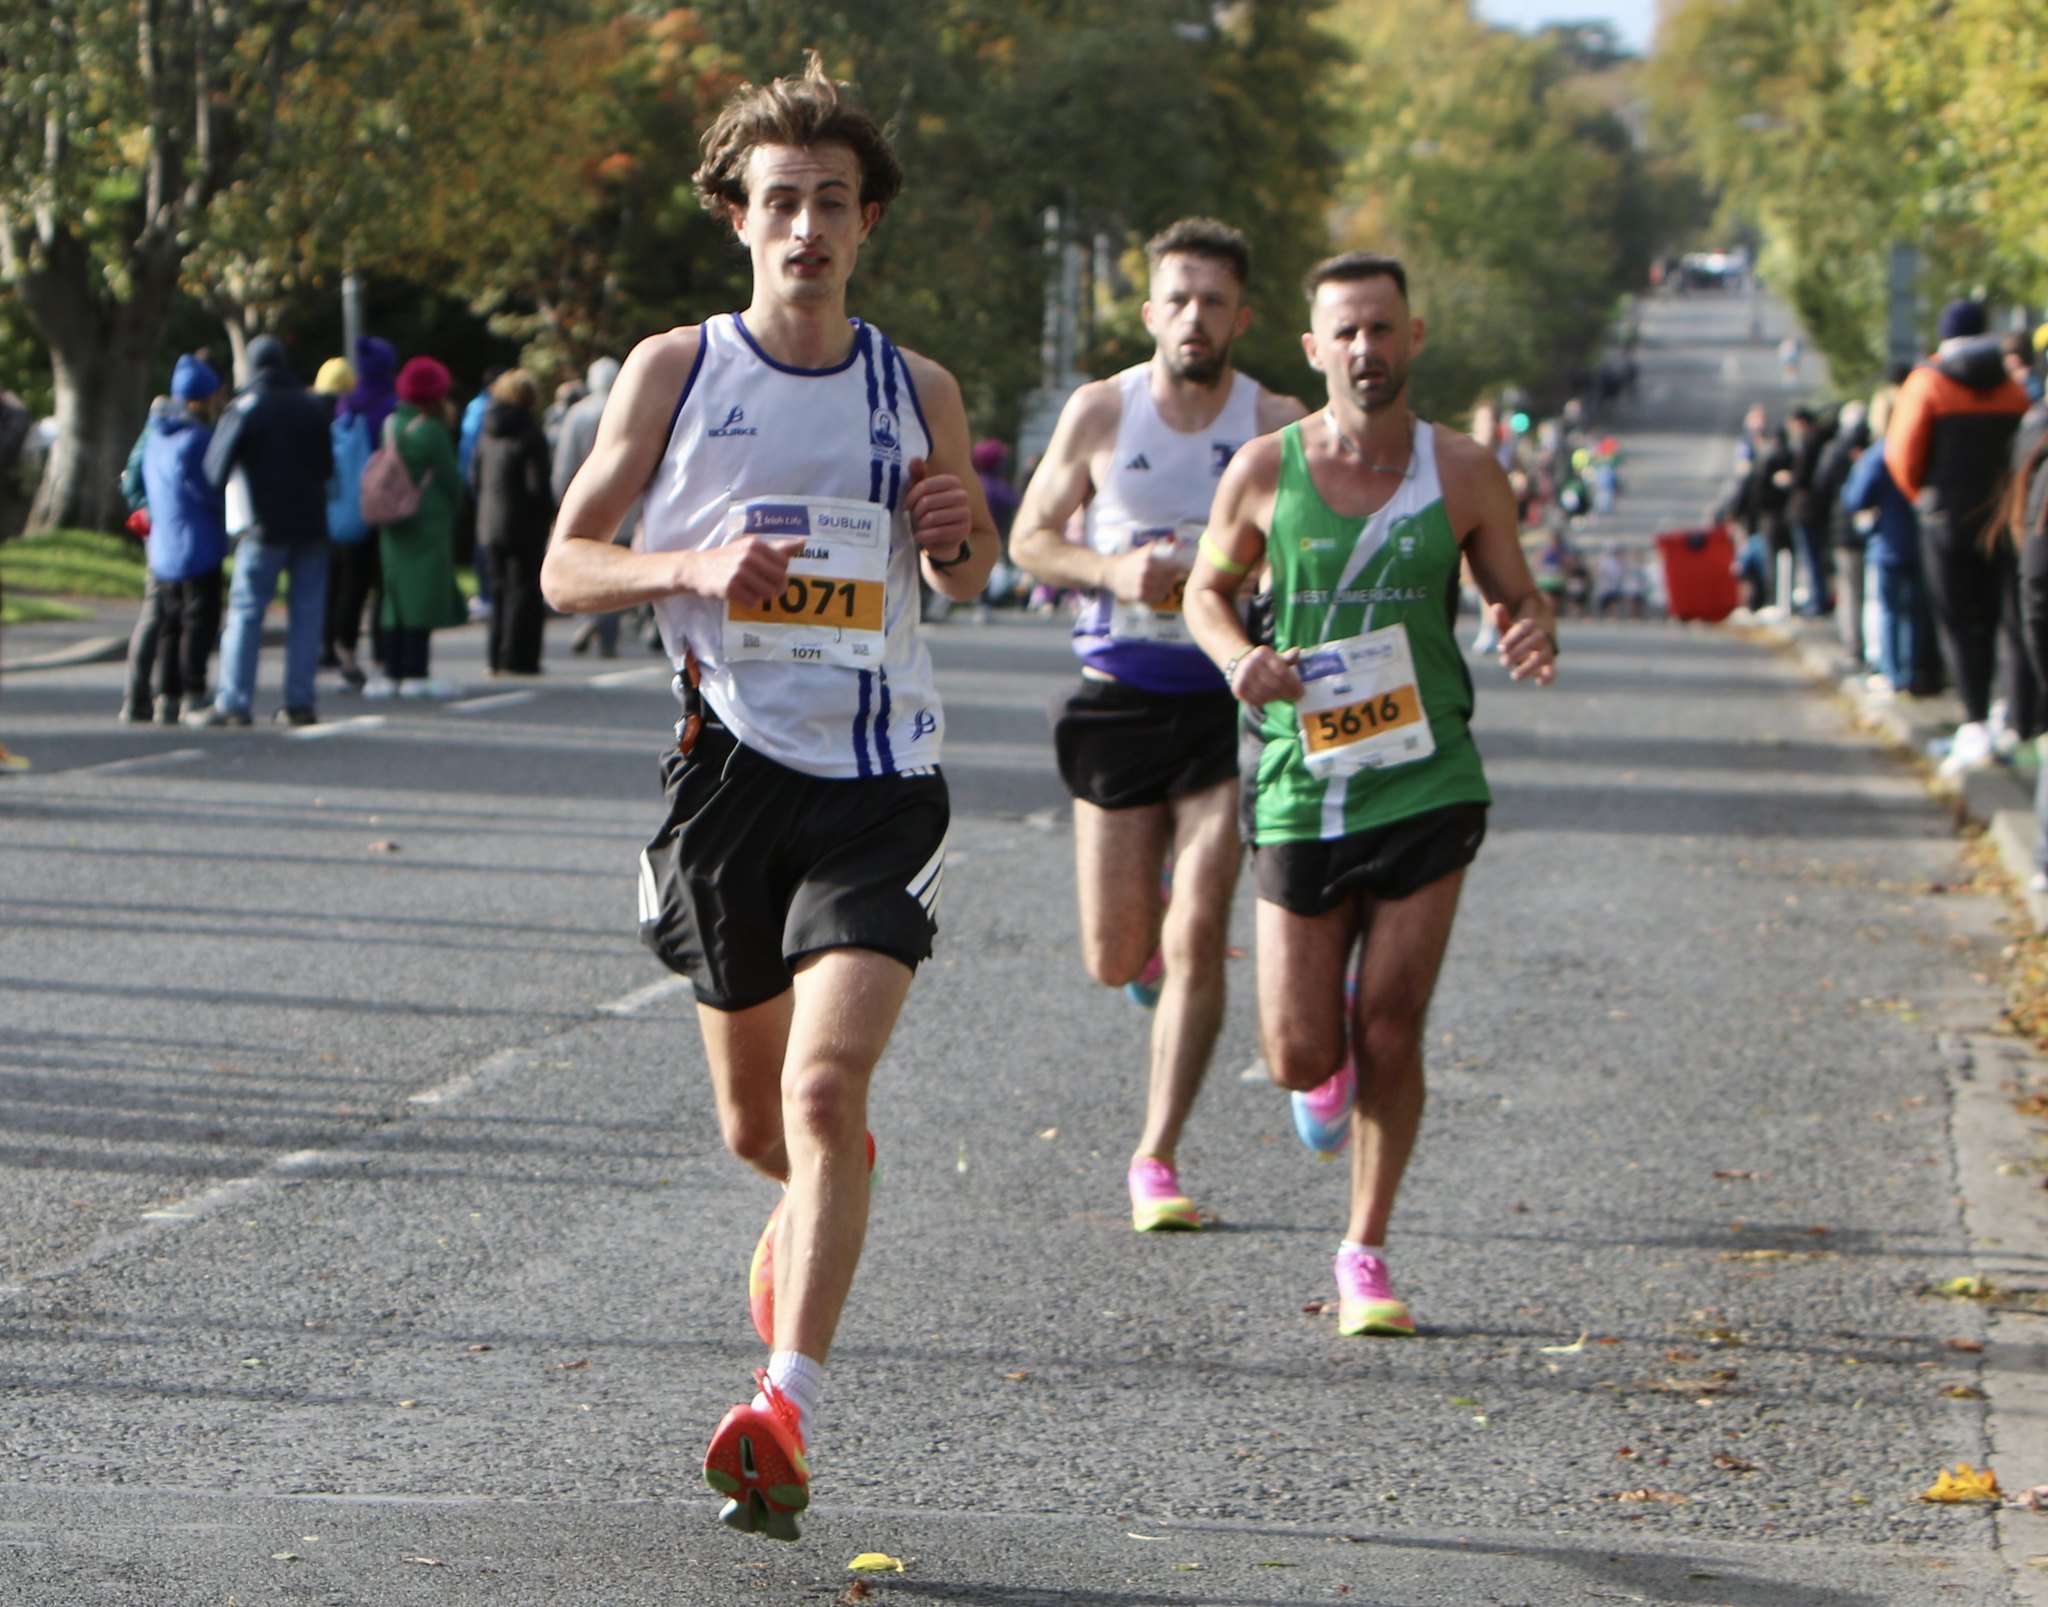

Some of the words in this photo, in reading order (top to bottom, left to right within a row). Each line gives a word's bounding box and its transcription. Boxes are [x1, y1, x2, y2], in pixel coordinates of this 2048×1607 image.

[708, 427, 757, 437] BOURKE
[764, 516, 783, 527] Irish
[785, 517, 802, 526] Life
[817, 512, 871, 531] DUBLIN
[792, 648, 821, 659] 1071
[1319, 694, 1399, 741] 5616
